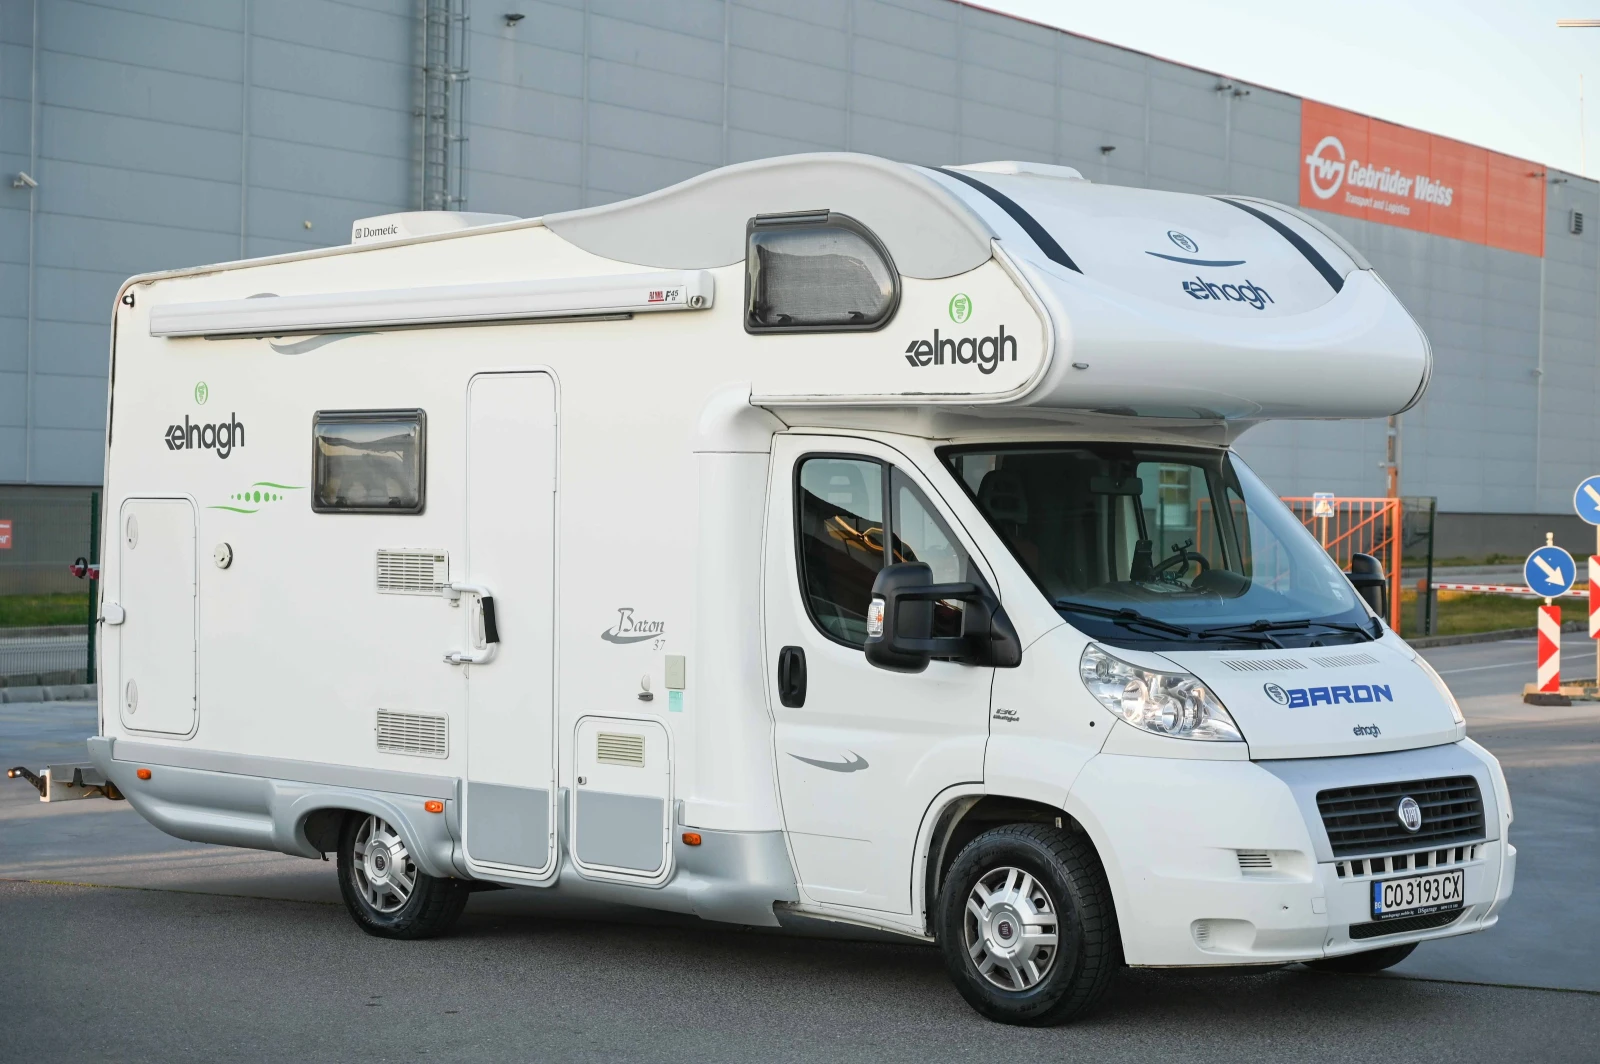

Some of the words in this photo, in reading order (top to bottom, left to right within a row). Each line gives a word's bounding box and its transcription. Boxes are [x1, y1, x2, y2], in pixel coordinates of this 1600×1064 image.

[1347, 159, 1413, 197] Gebrüder
[1414, 175, 1453, 207] Weiss
[1345, 191, 1373, 209] Transport
[363, 224, 398, 238] Dometic
[1182, 276, 1275, 310] elnagh
[905, 324, 1017, 375] elnagh
[164, 411, 244, 459] elnagh
[617, 607, 665, 633] Baron
[653, 639, 666, 651] 37
[1286, 684, 1394, 709] BARON
[1353, 723, 1381, 738] elnagh
